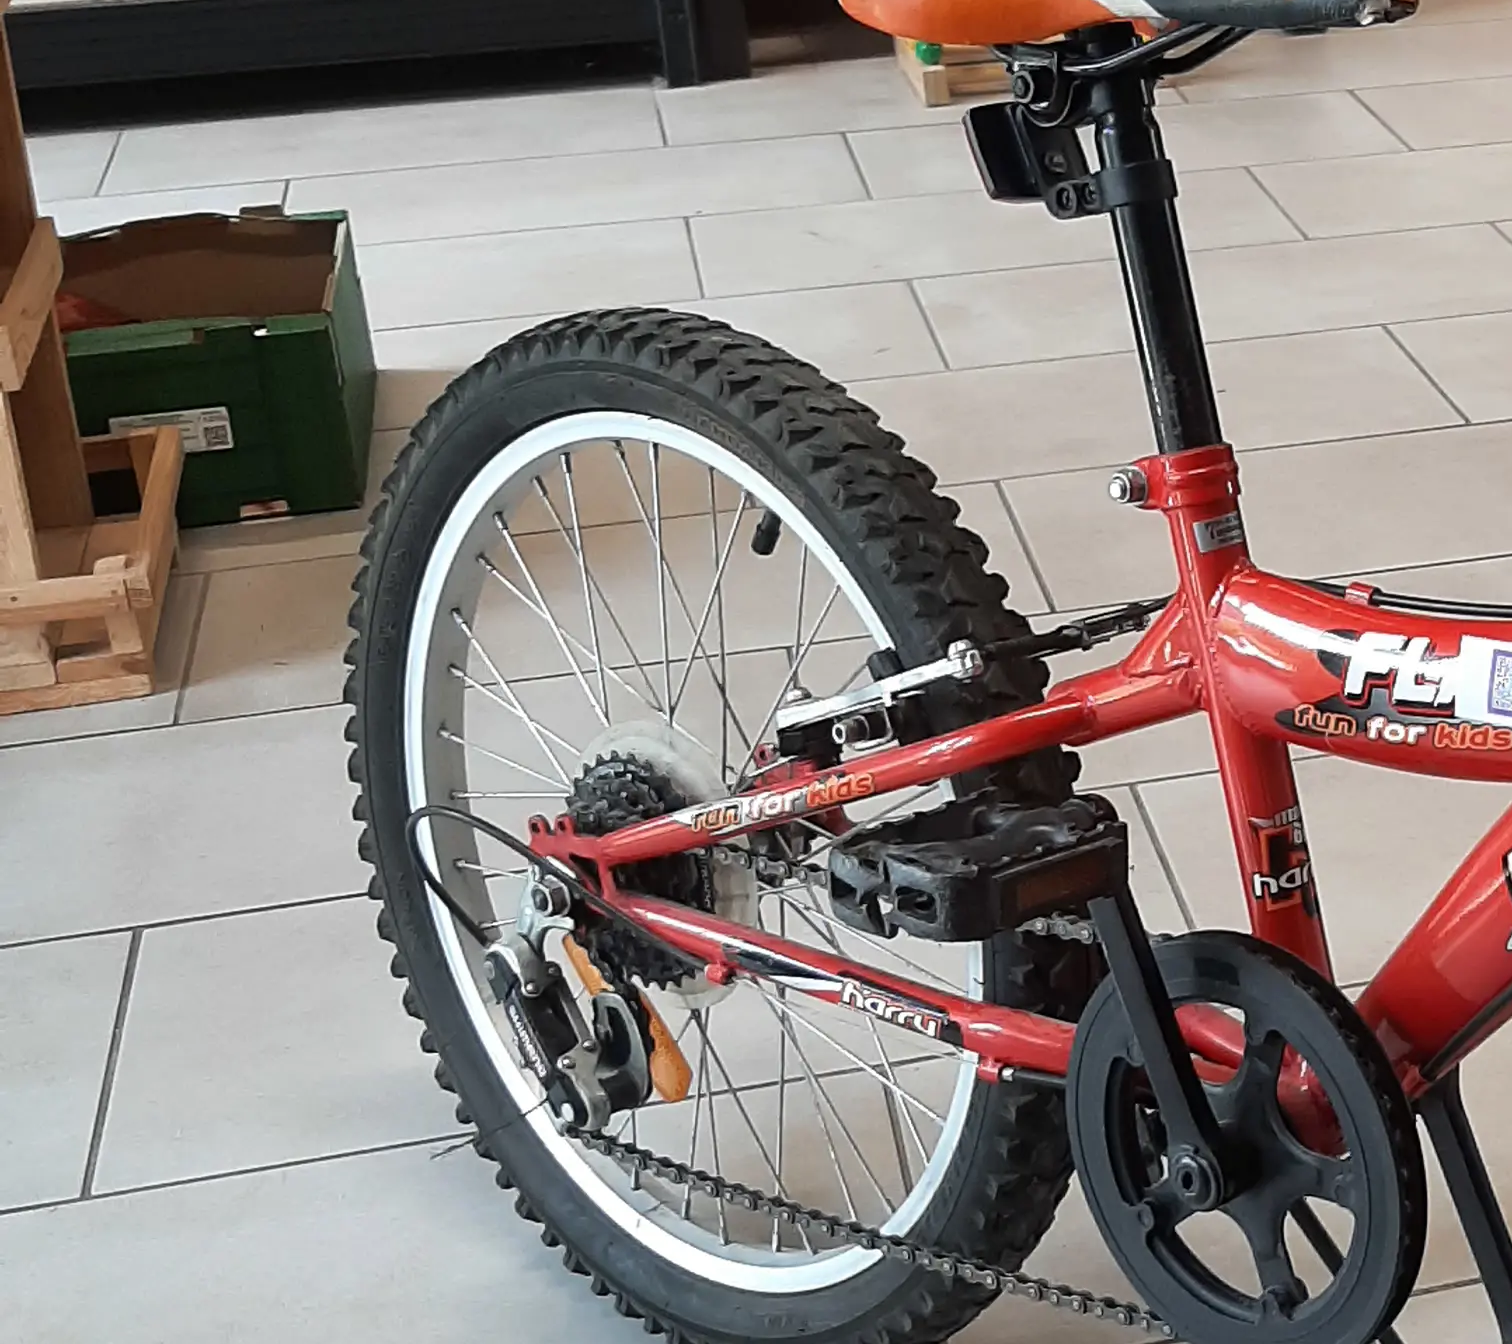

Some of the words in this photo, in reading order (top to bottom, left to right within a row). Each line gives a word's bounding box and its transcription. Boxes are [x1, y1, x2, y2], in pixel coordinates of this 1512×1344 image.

[1293, 704, 1356, 736] fun
[1366, 717, 1427, 744] for
[748, 789, 800, 820] for
[841, 979, 938, 1038] harry
